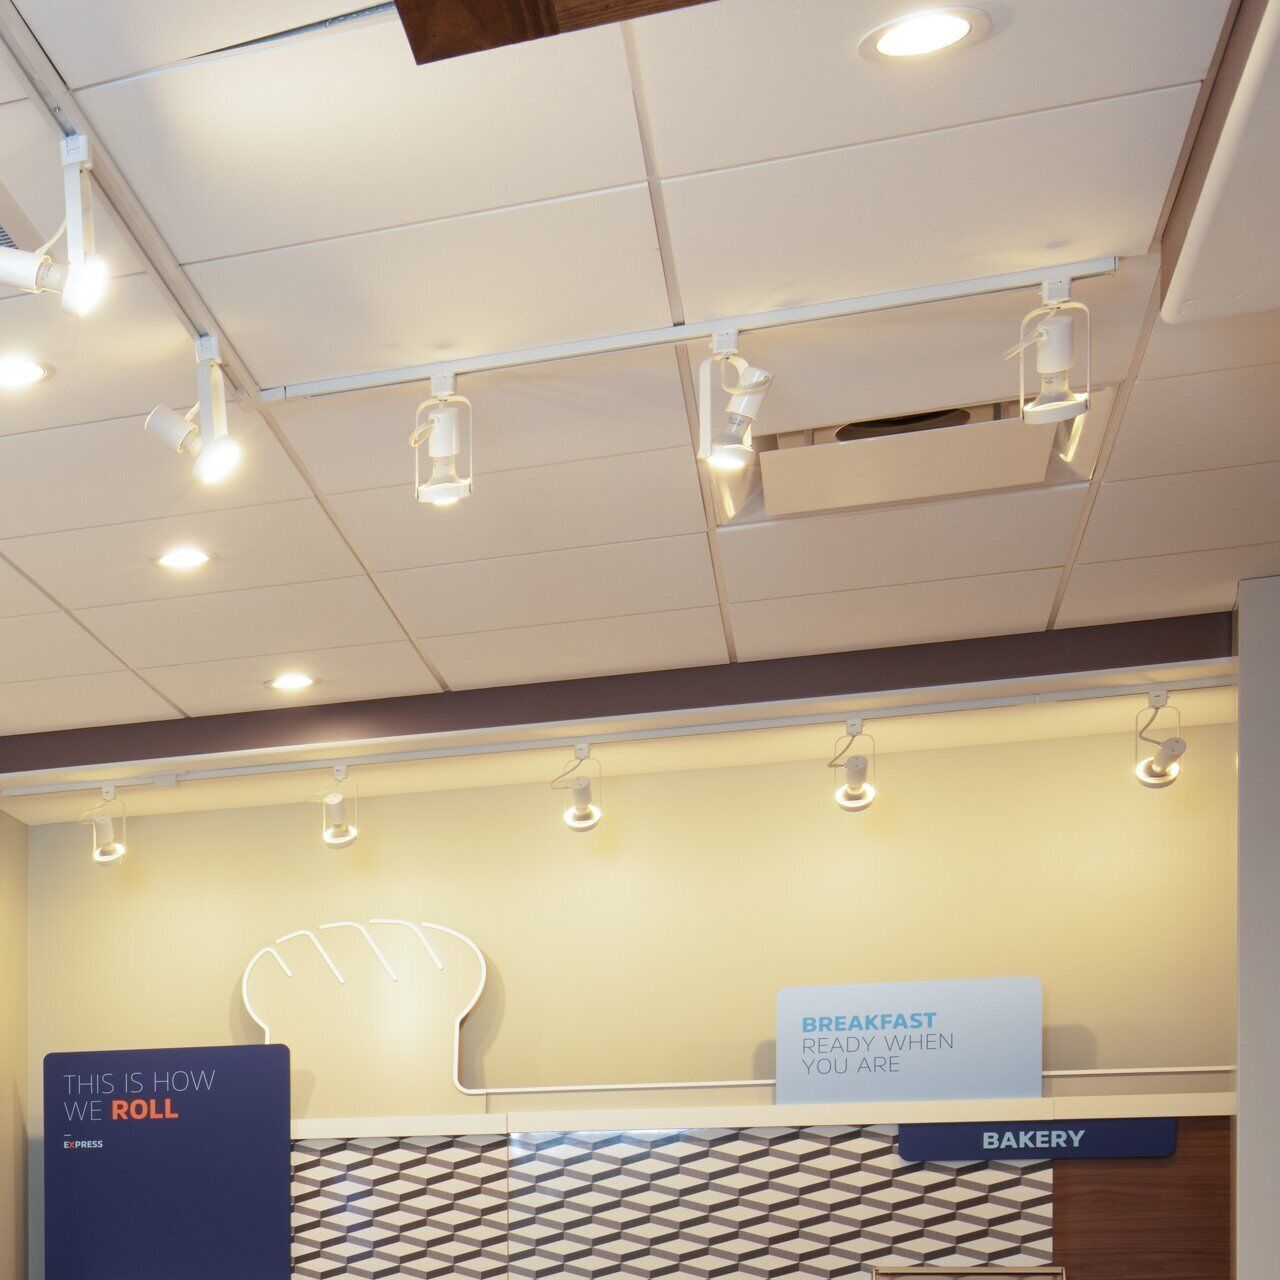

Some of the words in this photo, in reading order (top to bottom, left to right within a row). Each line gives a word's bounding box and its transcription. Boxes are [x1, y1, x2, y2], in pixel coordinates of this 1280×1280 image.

[802, 1012, 937, 1033] BREAKFAST
[802, 1036, 875, 1054] READY
[883, 1033, 954, 1051] WHEN
[801, 1058, 848, 1075] YOU
[857, 1056, 900, 1073] ARE
[63, 1073, 115, 1095] THIS
[124, 1071, 143, 1094] IS
[153, 1070, 216, 1092] HOW
[63, 1100, 102, 1122] WE
[111, 1098, 179, 1120] ROLL
[63, 1140, 103, 1149] EXPRESS
[983, 1129, 1086, 1149] BAKERY
